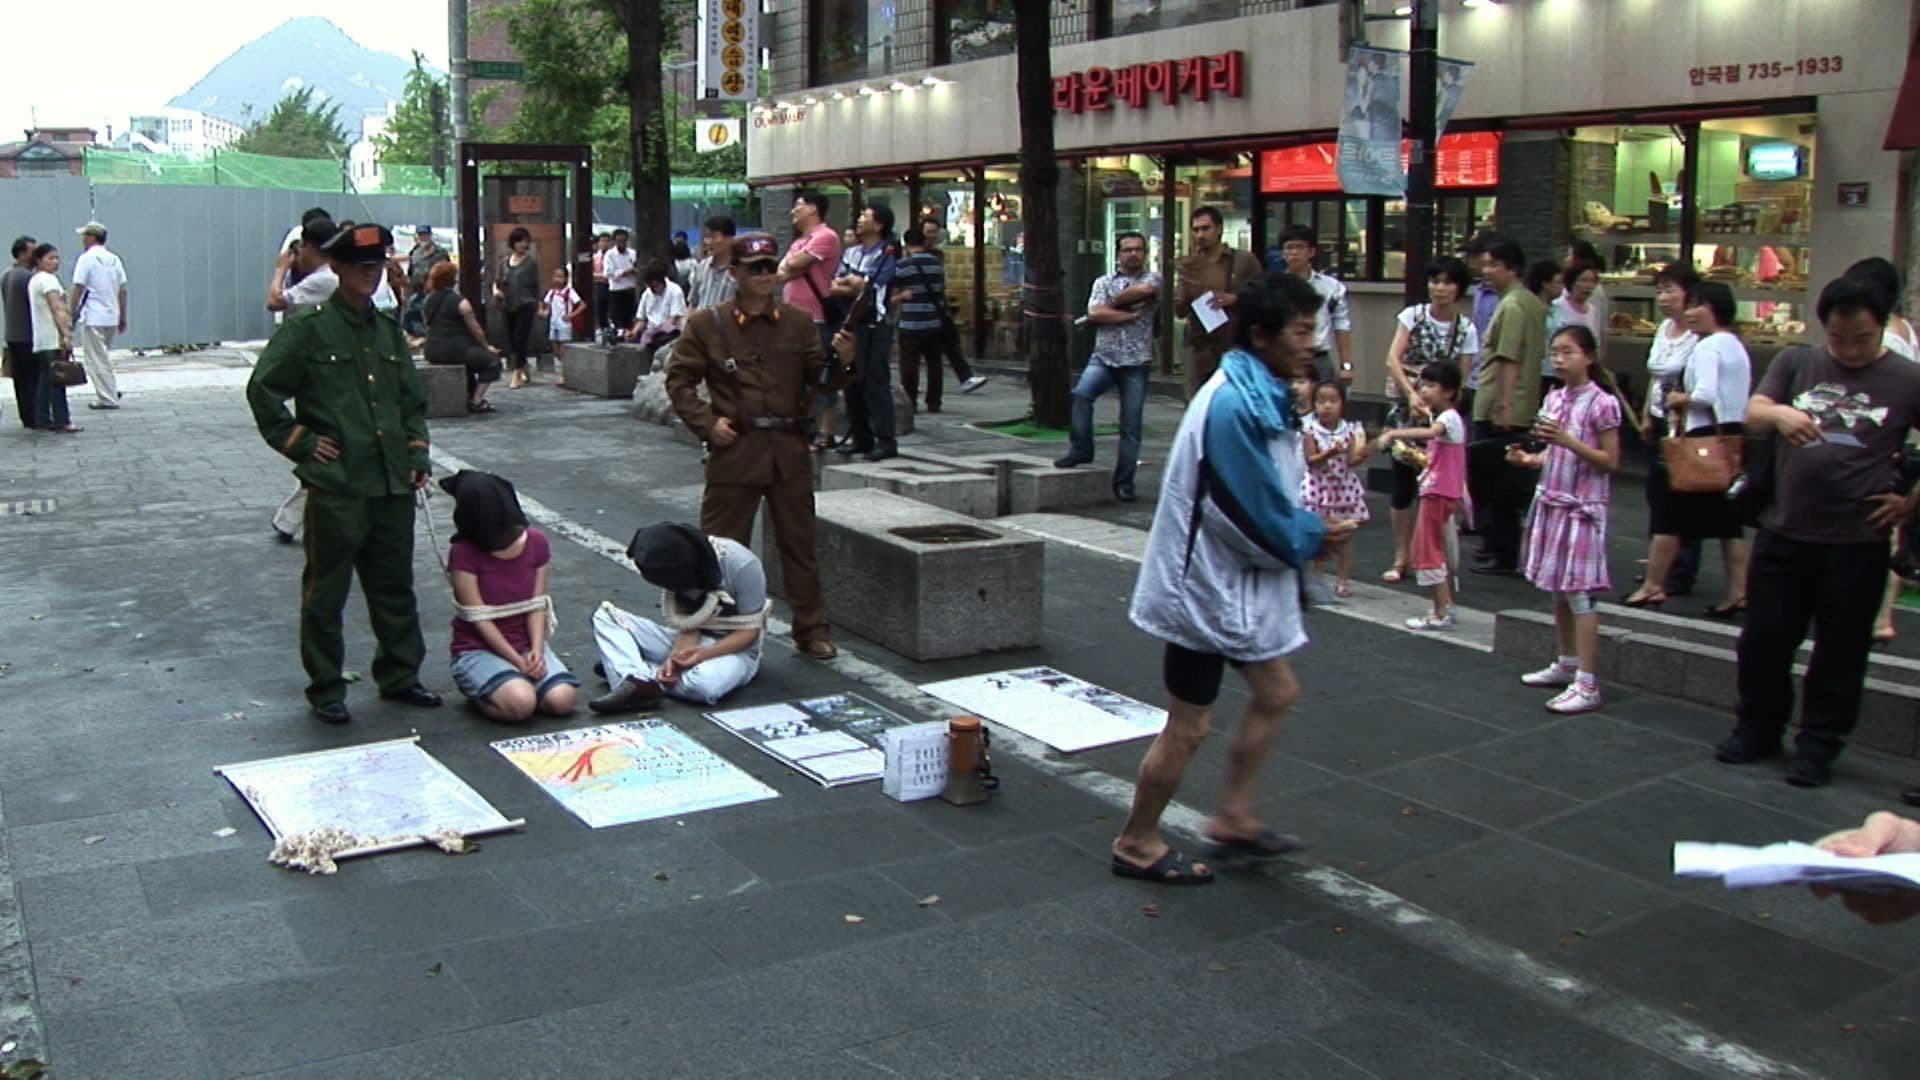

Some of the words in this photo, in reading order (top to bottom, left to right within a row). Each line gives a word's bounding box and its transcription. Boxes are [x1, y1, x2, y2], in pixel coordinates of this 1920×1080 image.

[1051, 50, 1243, 114] 라운베이커리
[1688, 63, 1741, 86] 안국점
[1747, 54, 1844, 81] 735-1933
